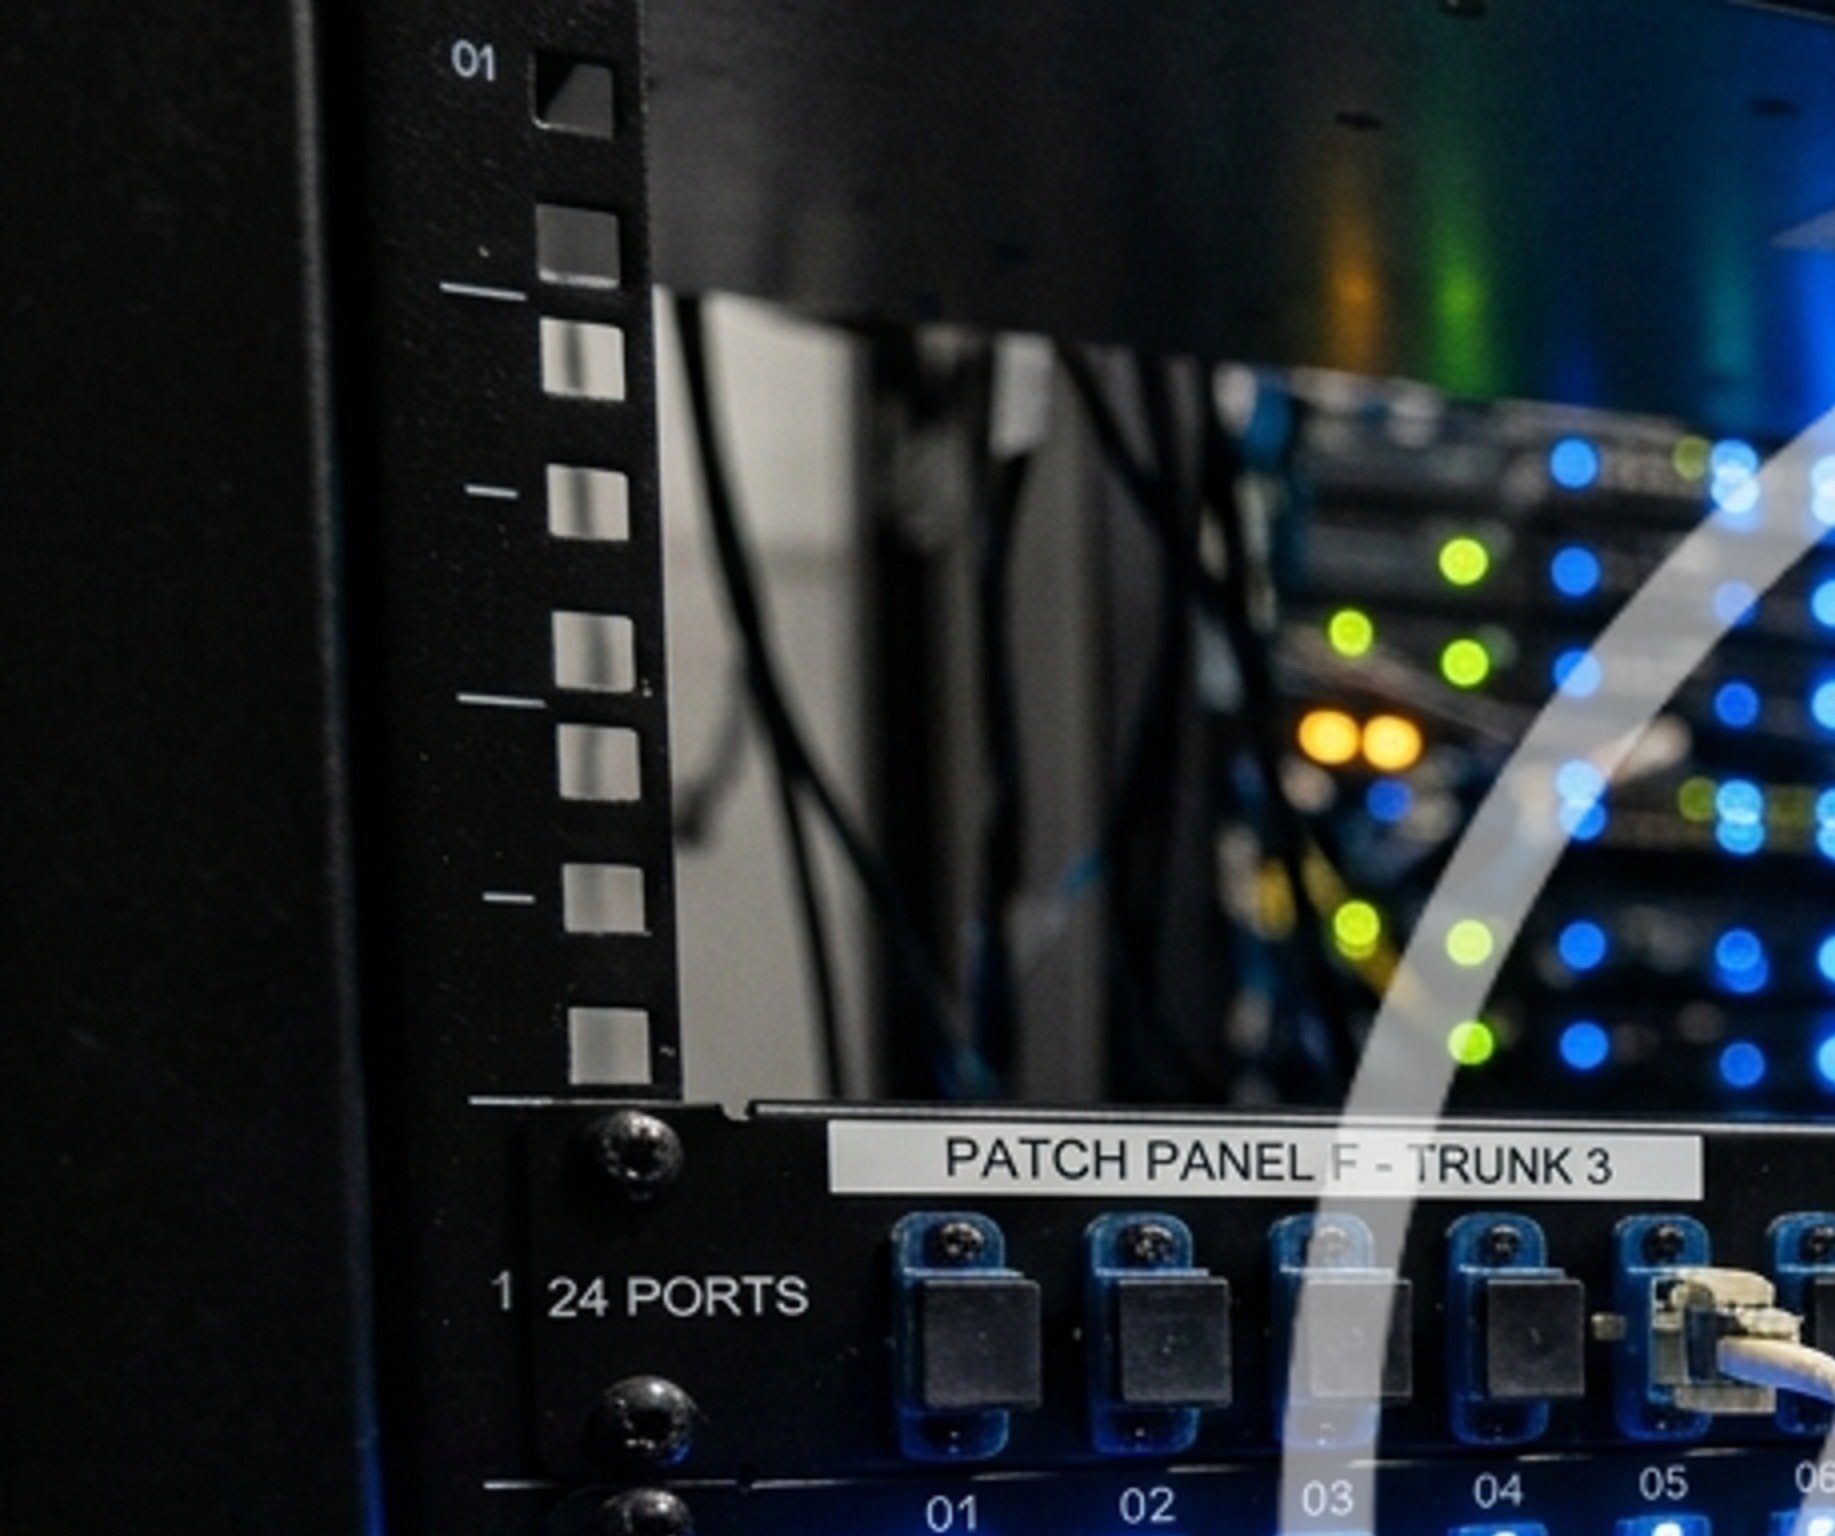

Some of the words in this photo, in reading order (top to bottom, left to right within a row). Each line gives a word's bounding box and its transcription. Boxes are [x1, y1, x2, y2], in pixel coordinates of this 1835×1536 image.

[451, 39, 497, 82] 01
[946, 1137, 1127, 1181] PATCH
[1146, 1139, 1314, 1183] PANEL
[1333, 1143, 1359, 1182] F
[1408, 1143, 1573, 1185] TRUNK
[1587, 1146, 1613, 1186] 3
[547, 1275, 609, 1318] 24
[626, 1275, 809, 1318] PORTS
[1301, 1478, 1354, 1516] 03
[1473, 1473, 1524, 1508] 04
[1639, 1466, 1690, 1502] 05
[925, 1496, 979, 1533] 01
[1119, 1486, 1177, 1524] 02
